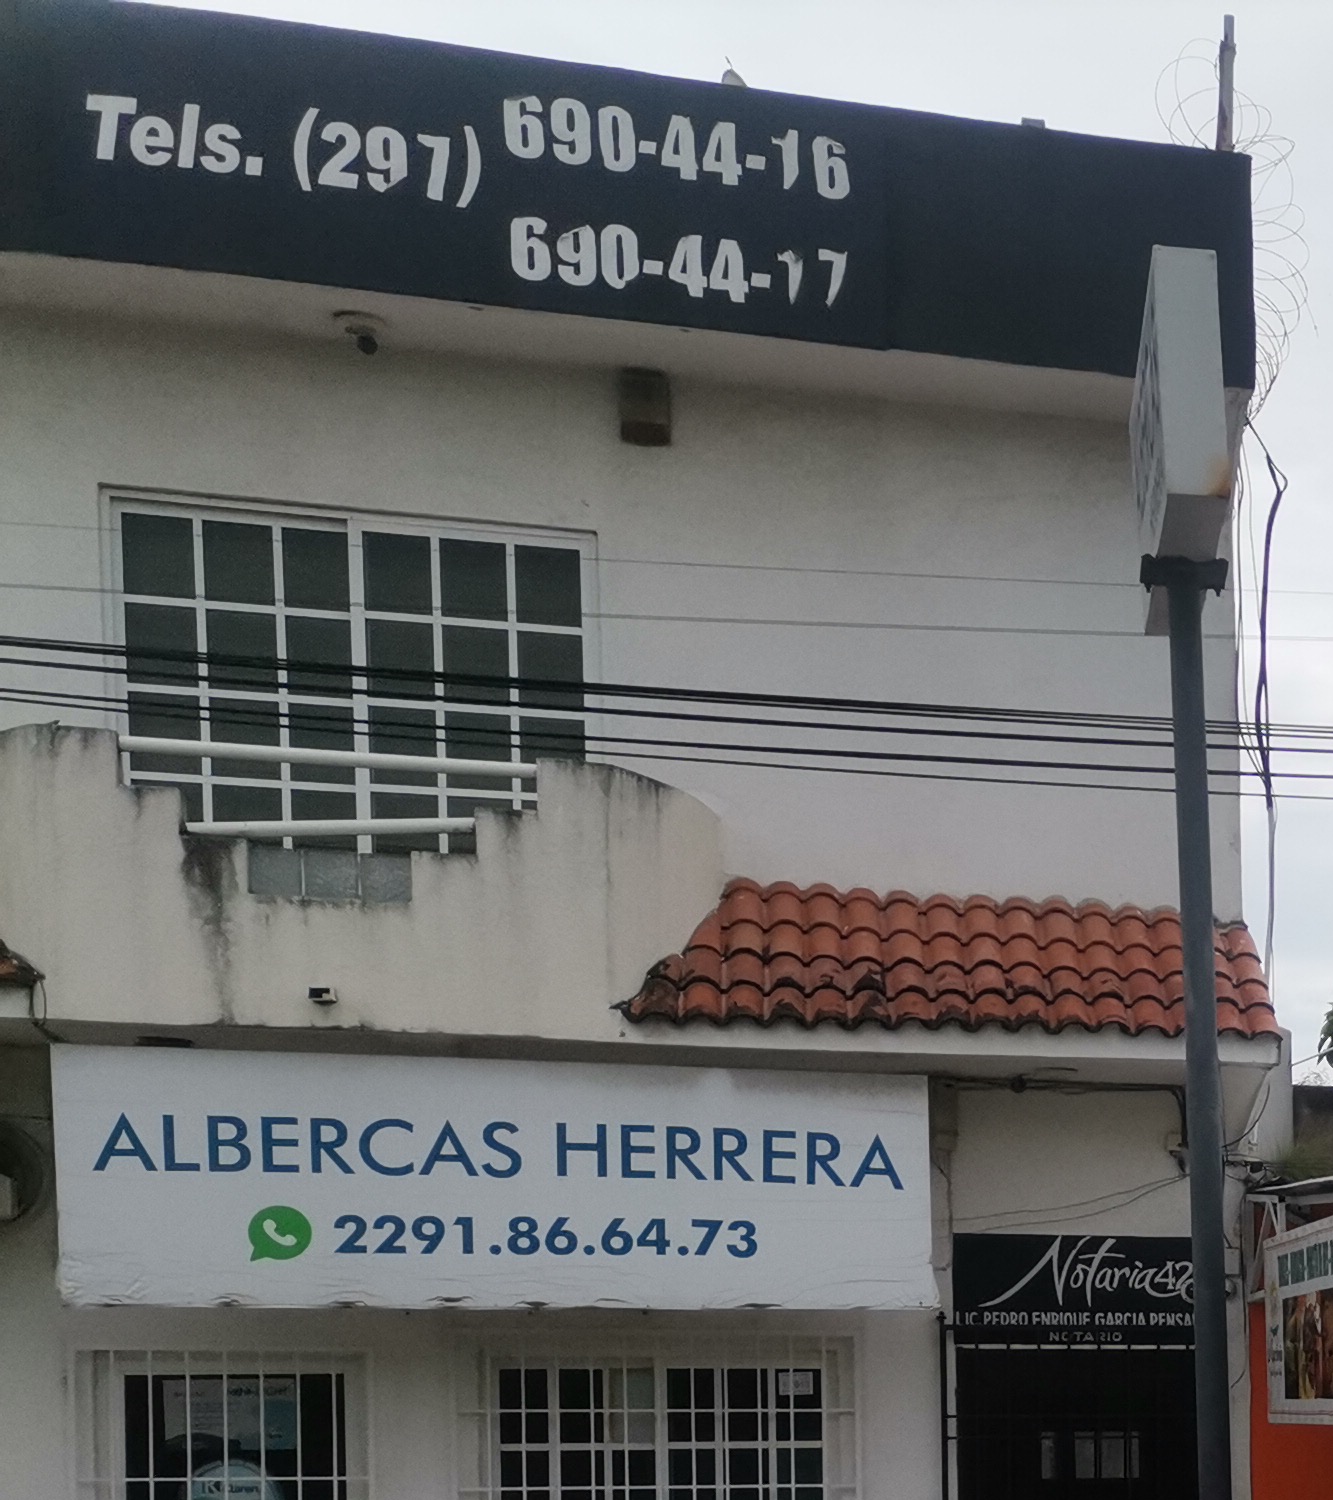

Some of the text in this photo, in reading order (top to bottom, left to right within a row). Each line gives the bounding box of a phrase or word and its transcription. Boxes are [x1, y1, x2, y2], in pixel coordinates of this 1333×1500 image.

[86, 94, 851, 209] Tels. (297) 690-44-16
[509, 216, 849, 308] 690-44-17
[92, 1112, 904, 1190] ALBERCAS HERRERA
[333, 1214, 758, 1259] 2291.86.64.73
[977, 1235, 1158, 1307] Notaria
[983, 1311, 1028, 1326] PEDRO
[1032, 1311, 1091, 1326] ENRIQUE
[1149, 1312, 1194, 1327] PENSA
